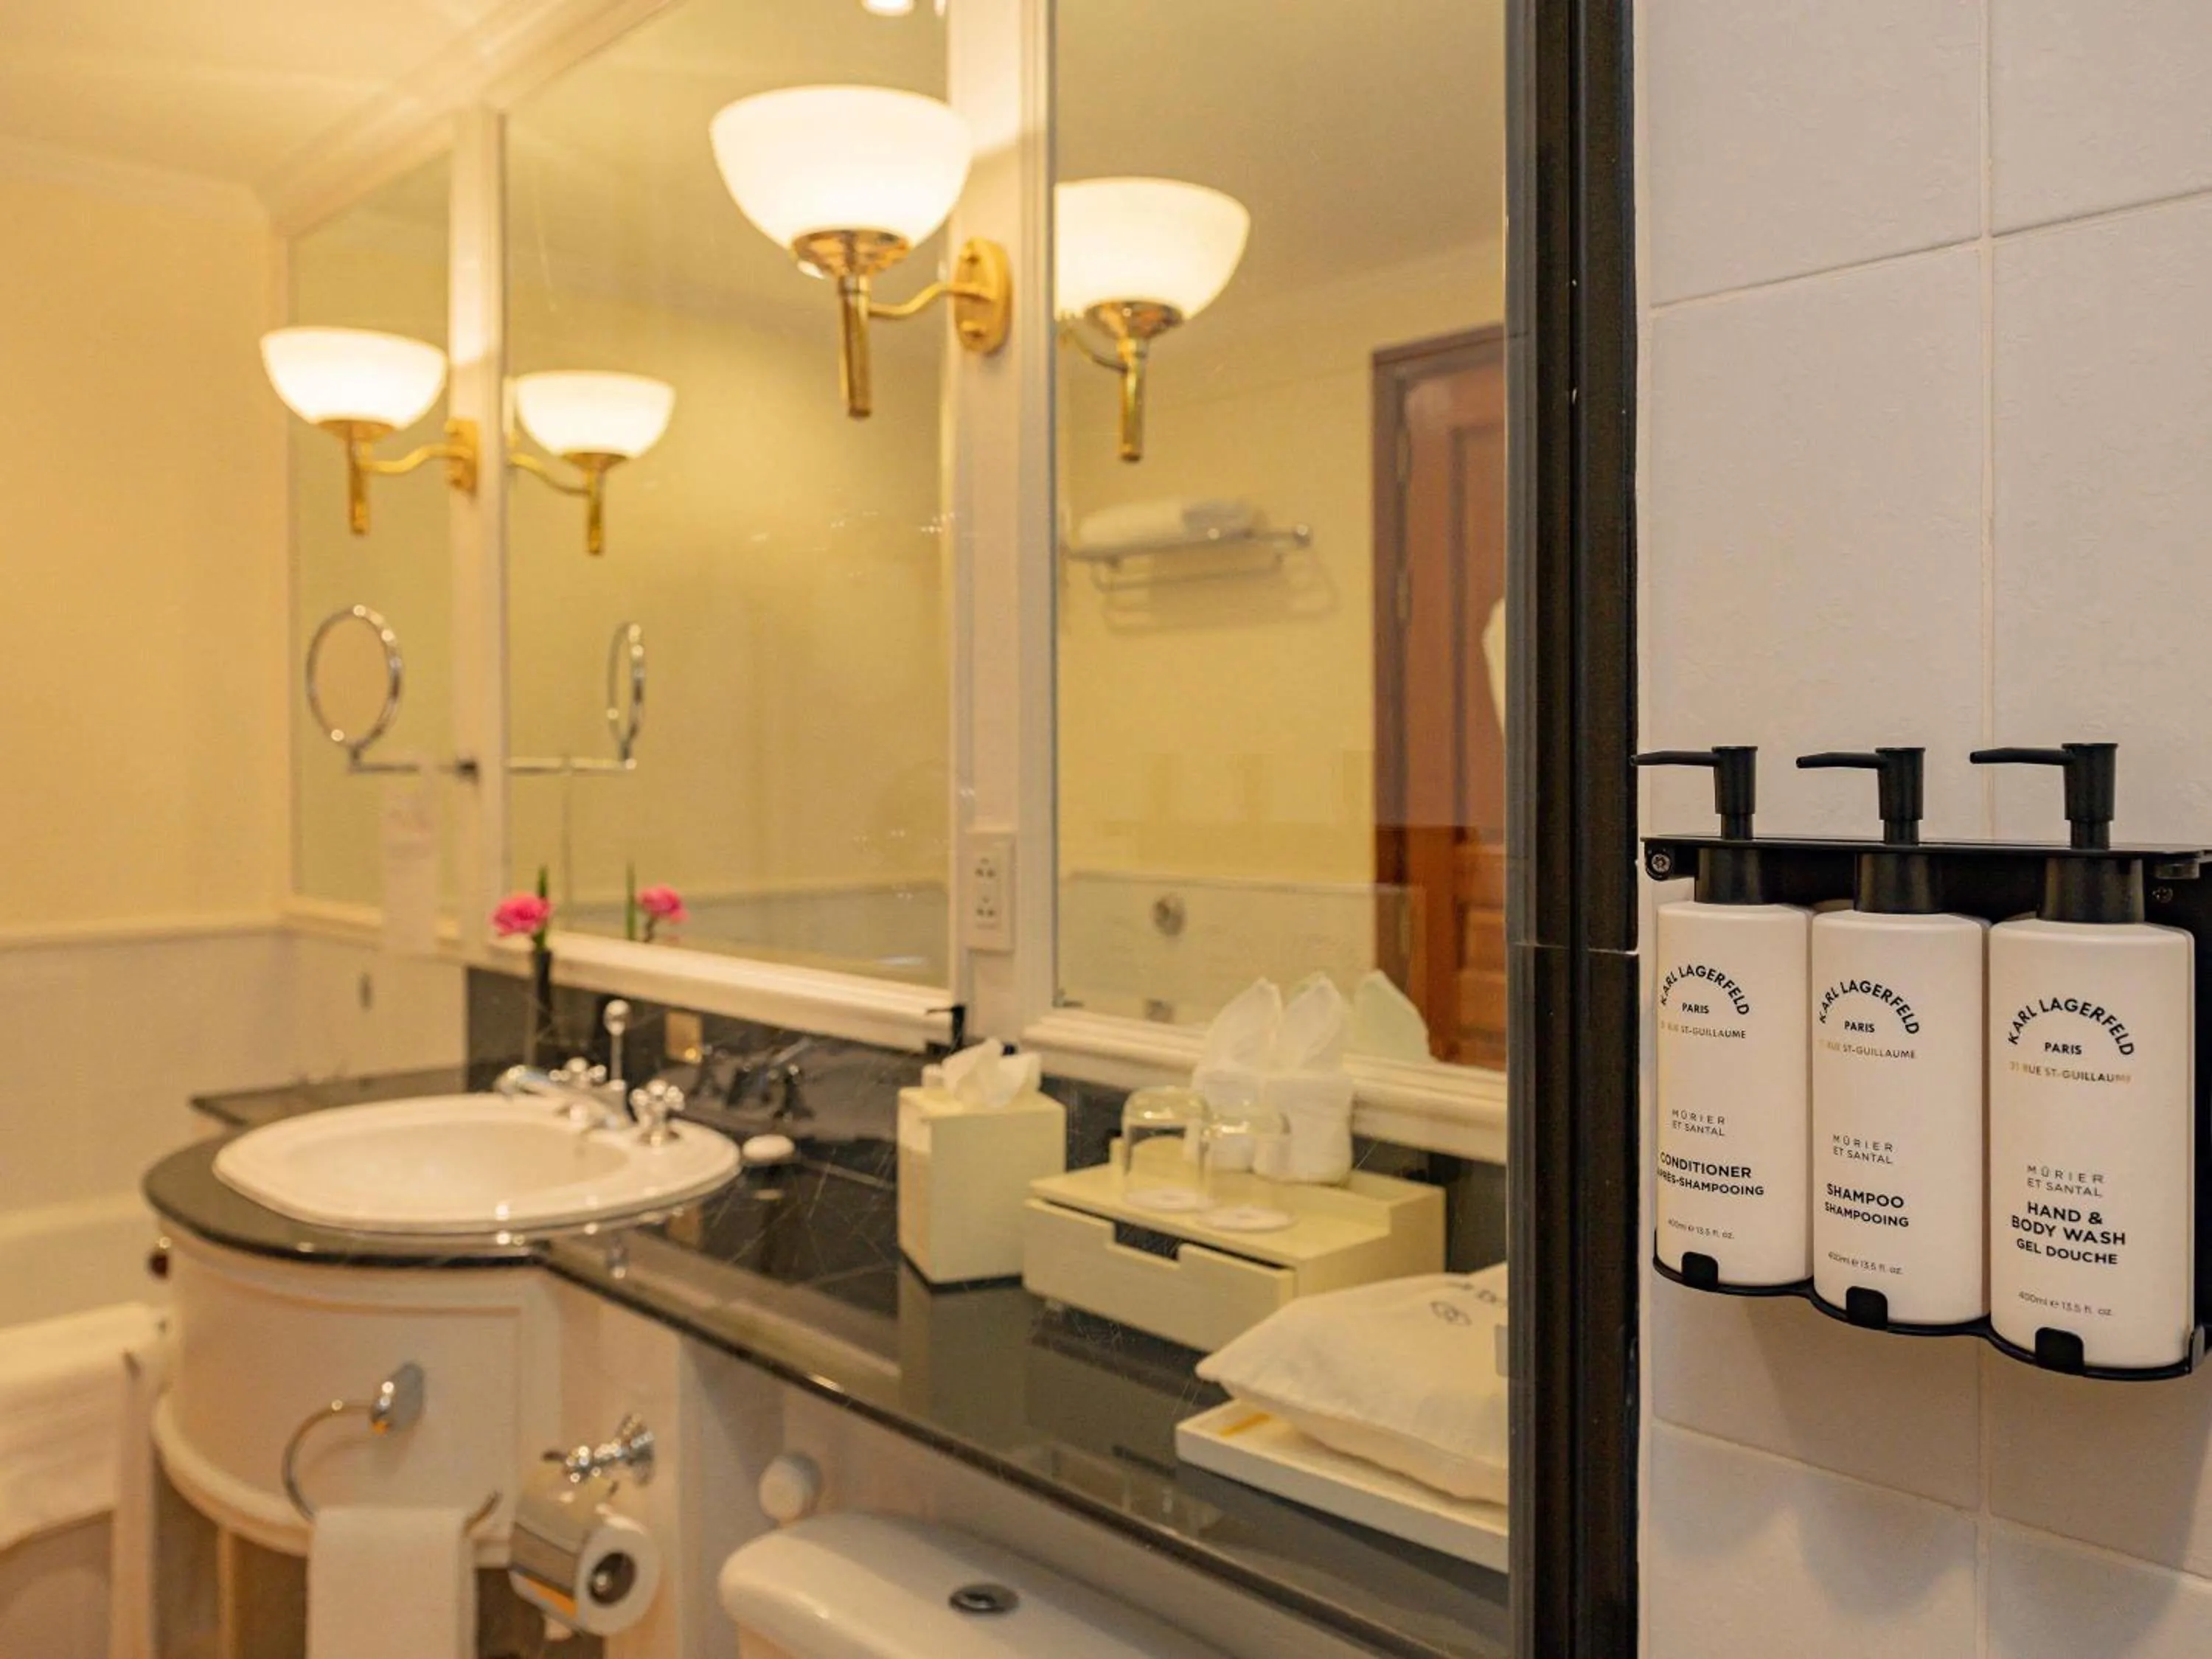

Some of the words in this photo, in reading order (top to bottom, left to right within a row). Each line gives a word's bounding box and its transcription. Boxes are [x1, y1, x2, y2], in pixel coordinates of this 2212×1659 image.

[1660, 971, 1678, 1006] KARL
[1677, 964, 1750, 1015] LAGERFELD
[1682, 1003, 1710, 1015] PARIS
[1818, 987, 1840, 1024] KARL
[1840, 979, 1920, 1034] LAGERFELD
[1844, 1020, 1876, 1033] PARIS
[2007, 1004, 2038, 1046] KARL
[2039, 997, 2135, 1056] LAGERFELD
[2044, 1041, 2082, 1055] PARIS
[1672, 1119, 1682, 1130] ET
[1685, 1123, 1725, 1137] SANTAL
[1660, 1151, 1752, 1179] CONDITIONER
[1833, 1147, 1844, 1156] ET
[1847, 1150, 1893, 1165] SANTAL
[1826, 1182, 1905, 1209] SHAMPOO
[2027, 1178, 2042, 1189] ET
[2046, 1181, 2103, 1198] SANTAL
[1824, 1201, 1910, 1228] SHAMPOOING
[2027, 1201, 2081, 1222] HAND
[2088, 1211, 2103, 1225] &
[2011, 1214, 2056, 1238] BODY
[2063, 1227, 2126, 1245] WASH
[2017, 1237, 2042, 1254] GEL
[2045, 1245, 2118, 1265] DOUCHE
